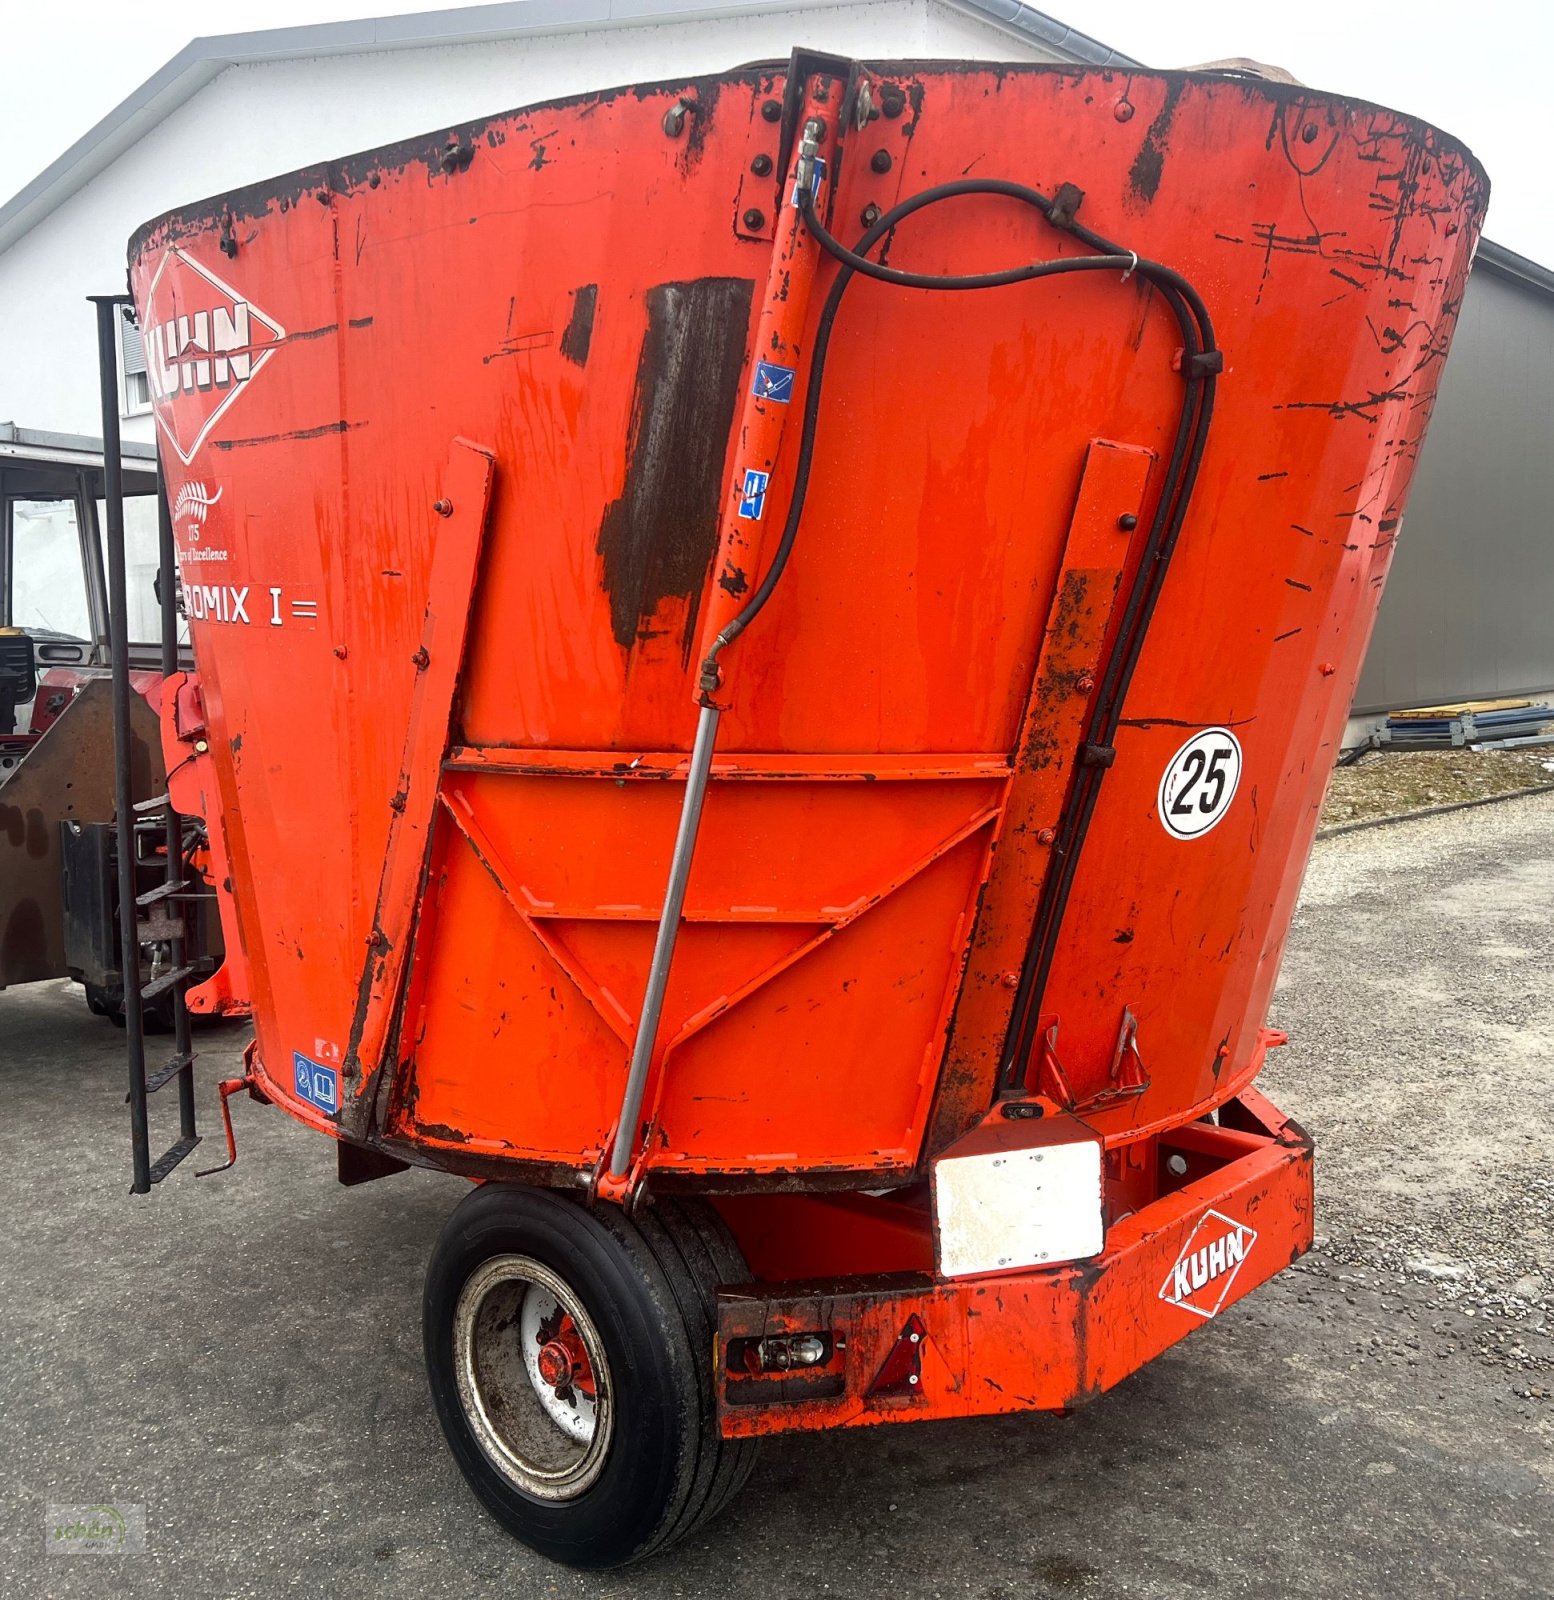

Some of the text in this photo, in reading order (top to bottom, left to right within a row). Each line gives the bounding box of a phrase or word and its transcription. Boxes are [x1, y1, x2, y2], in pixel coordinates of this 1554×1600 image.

[143, 302, 249, 398] KUHN
[188, 523, 200, 541] 175
[193, 546, 227, 560] Excellence
[1170, 749, 1233, 814] 25
[1174, 1226, 1244, 1303] KUHN
